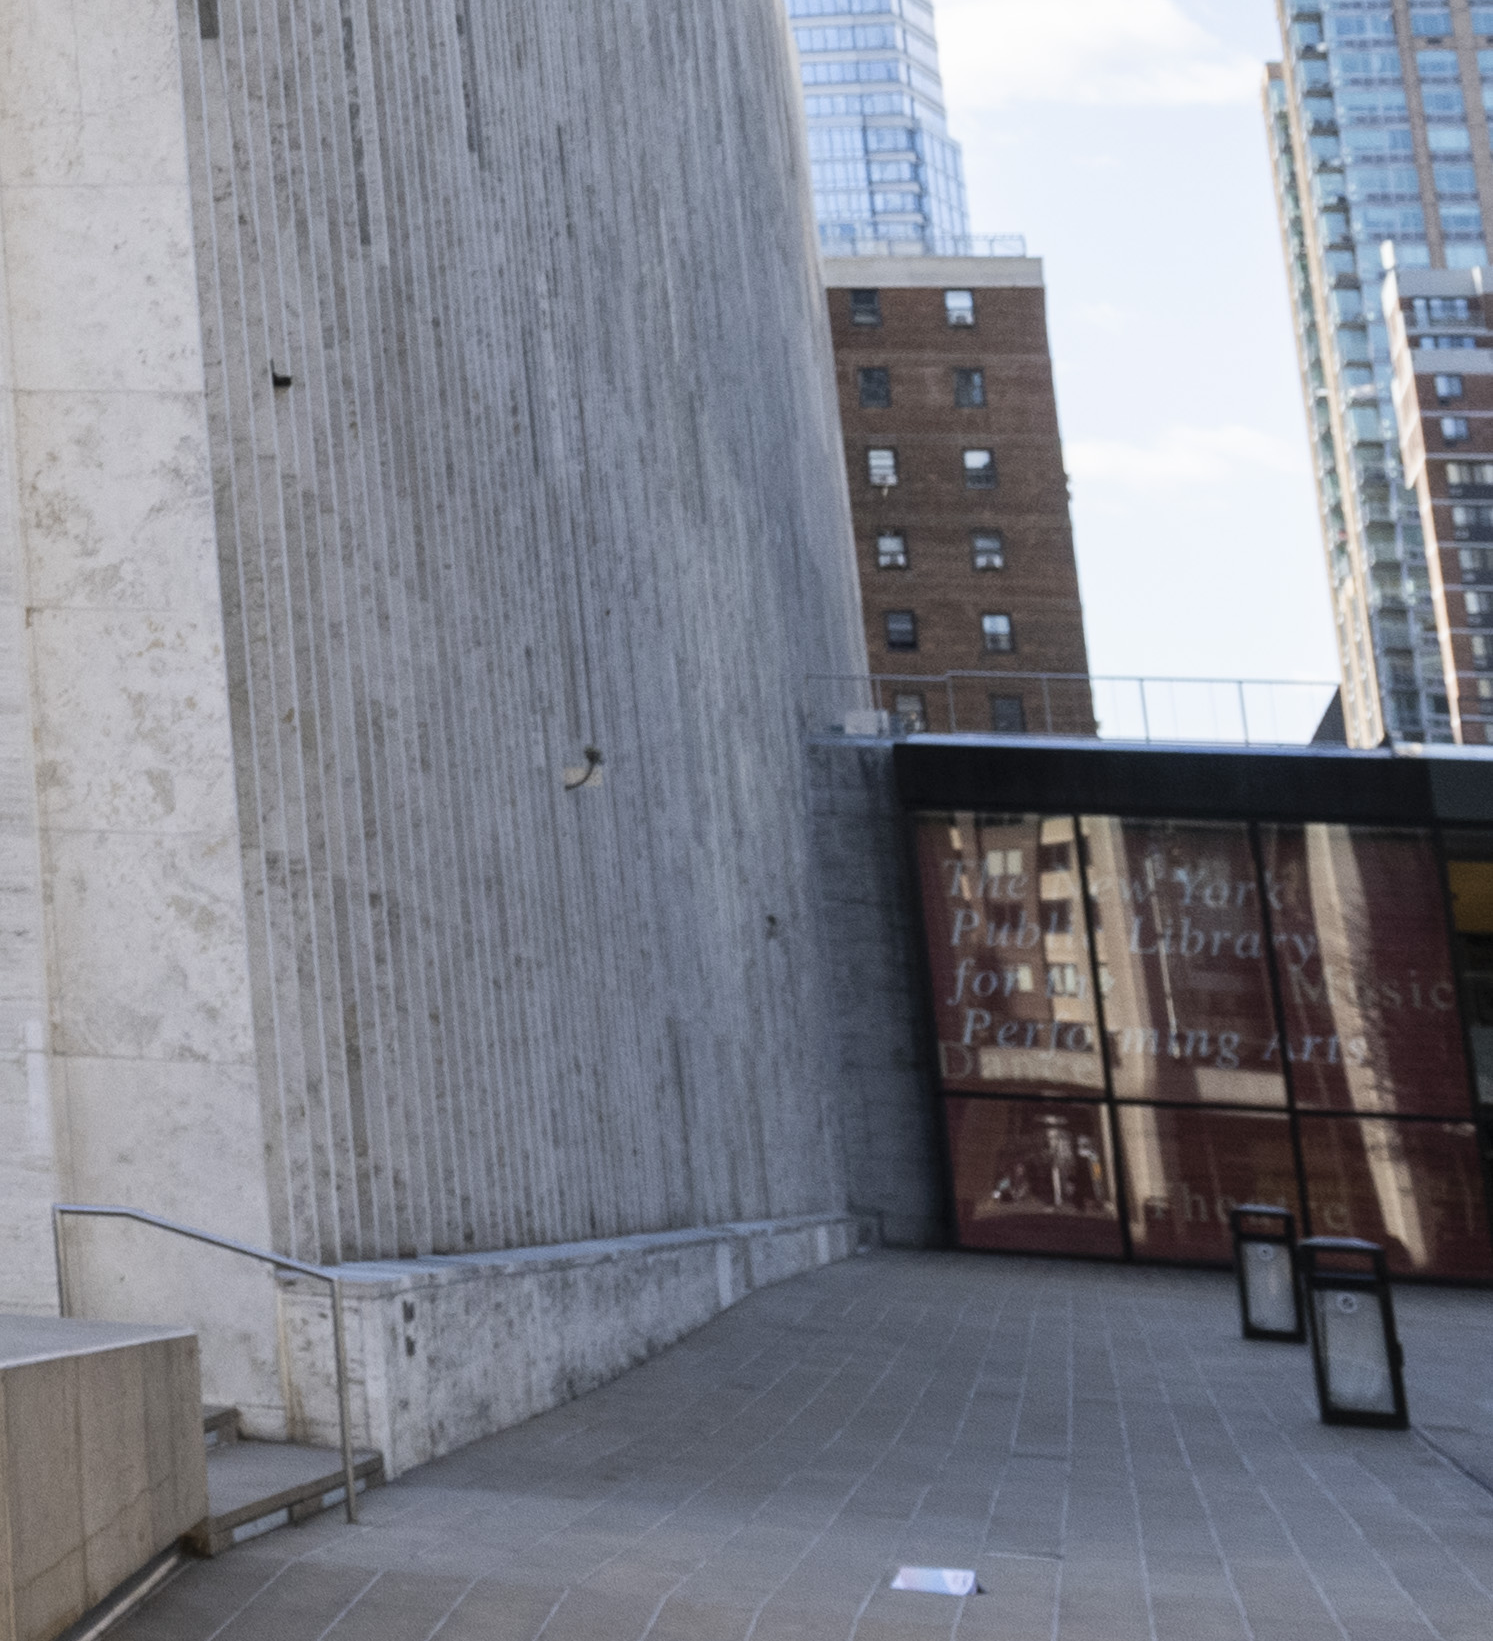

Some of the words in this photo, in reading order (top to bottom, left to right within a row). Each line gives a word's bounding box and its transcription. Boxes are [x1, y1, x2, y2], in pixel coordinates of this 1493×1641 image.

[1170, 865, 1285, 910] York
[1128, 915, 1317, 968] Library
[960, 1005, 1243, 1069] Perfoming
